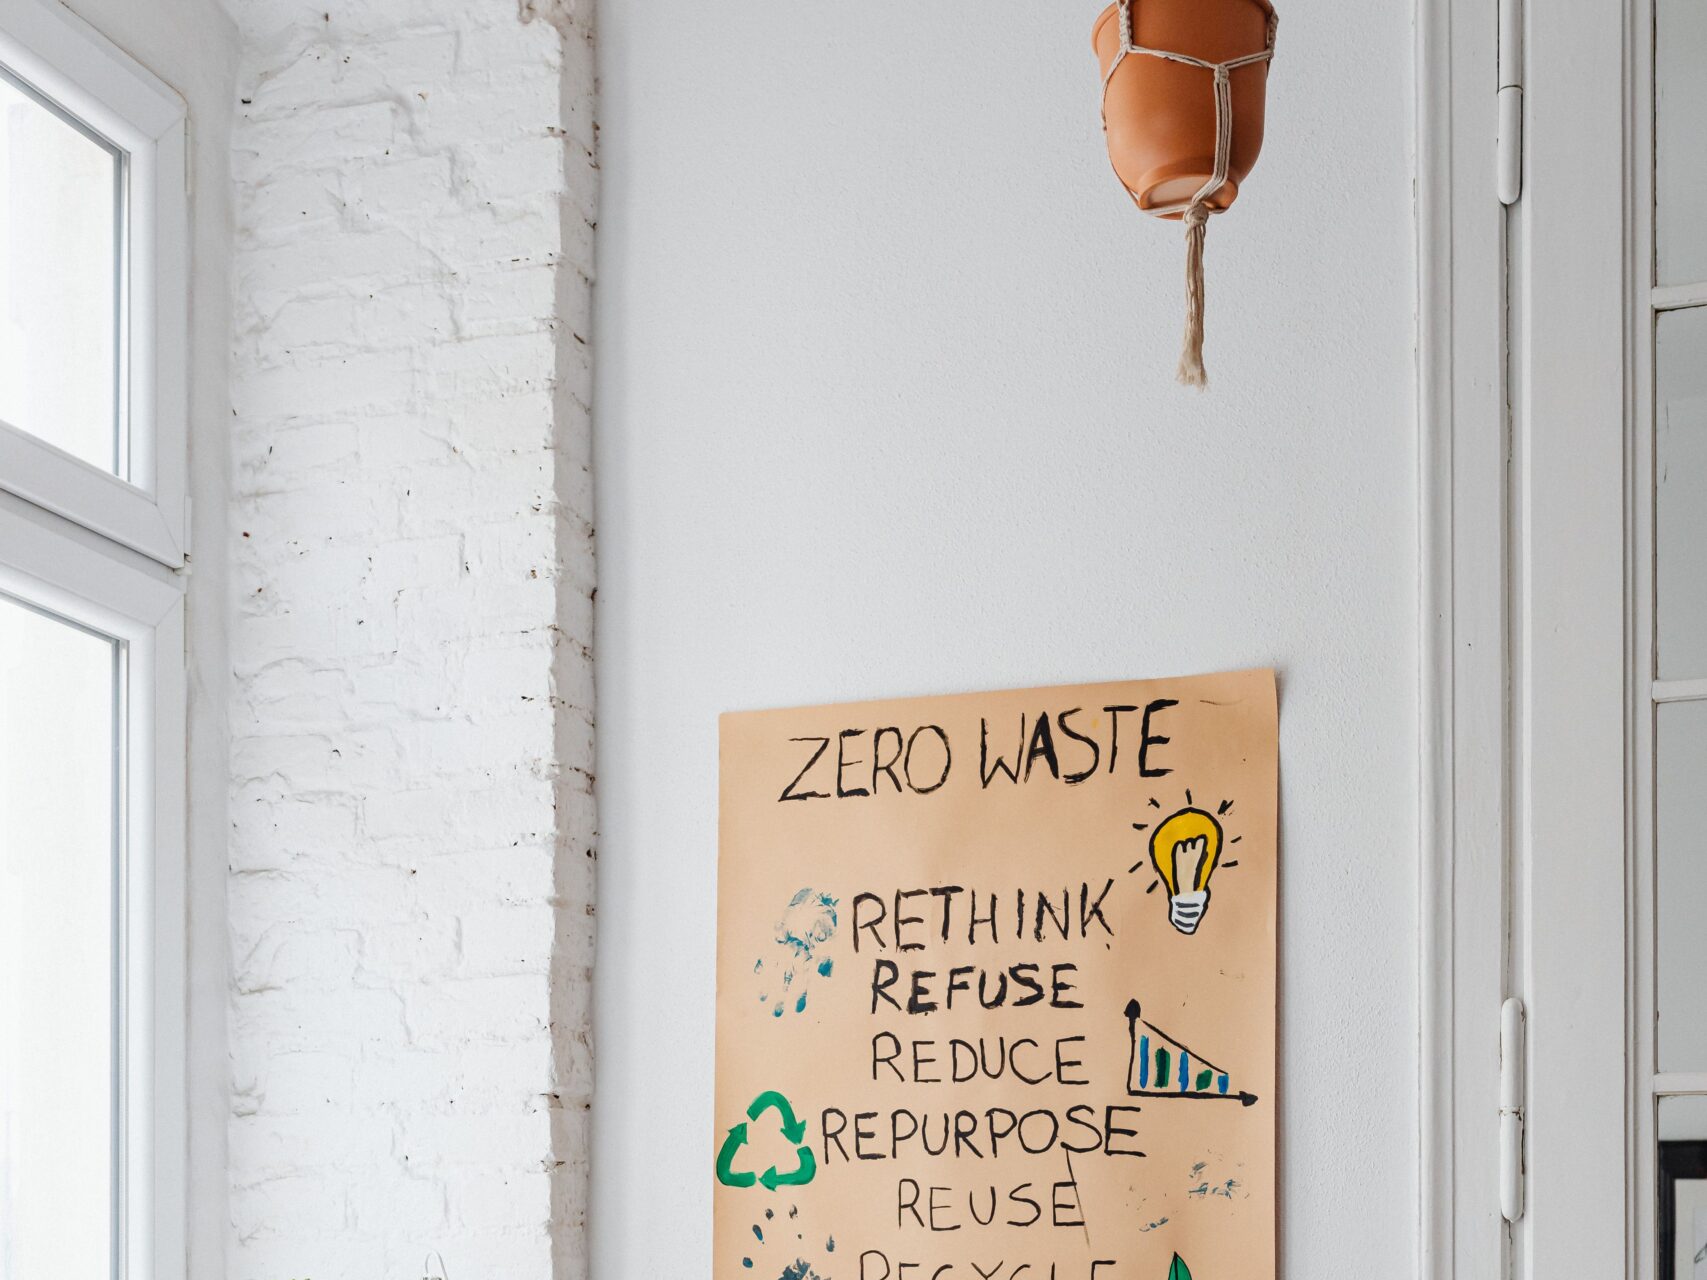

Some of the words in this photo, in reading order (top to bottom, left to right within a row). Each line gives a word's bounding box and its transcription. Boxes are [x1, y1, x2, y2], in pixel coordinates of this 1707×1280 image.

[778, 725, 951, 802] ZERO
[980, 699, 1180, 789] WASTE
[852, 878, 1116, 953] RETHINK
[871, 959, 1085, 1016] REFUSE
[872, 1031, 1090, 1086] REDUCE
[821, 1104, 1147, 1165] REPURPOSE
[898, 1178, 1086, 1232] REUSE
